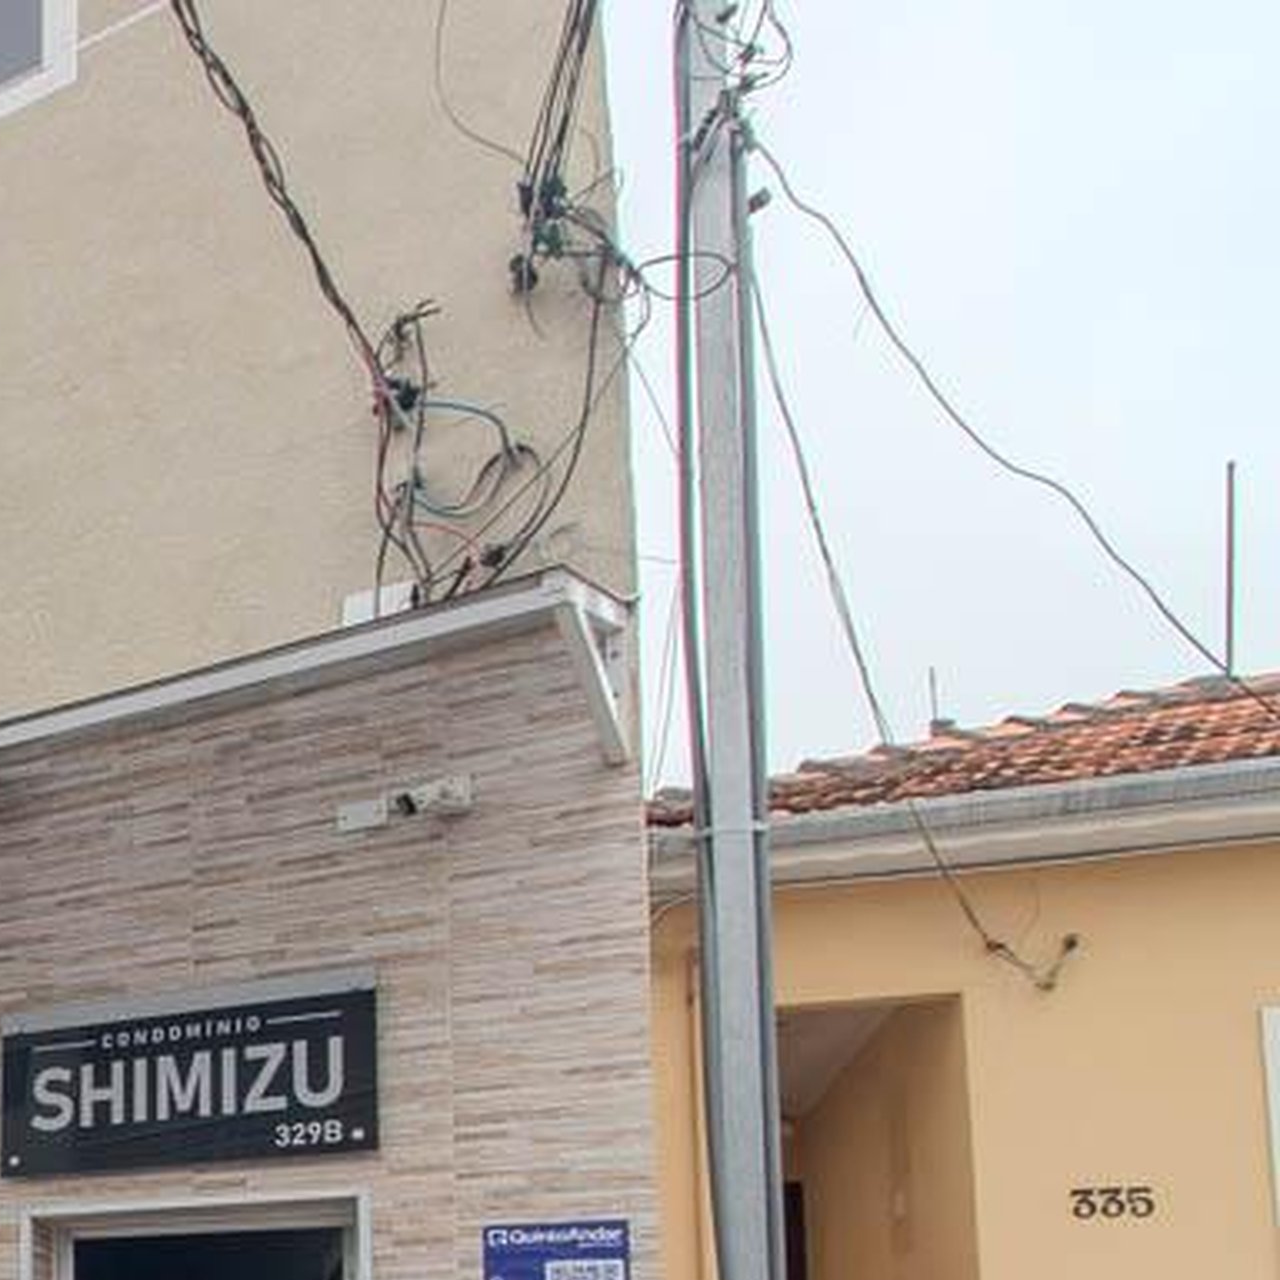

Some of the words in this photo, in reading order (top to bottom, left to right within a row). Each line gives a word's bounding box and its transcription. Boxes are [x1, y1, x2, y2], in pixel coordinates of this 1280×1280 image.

[30, 1035, 345, 1132] SHIMIZU
[274, 1119, 344, 1148] 329B
[1069, 1186, 1156, 1219] 335
